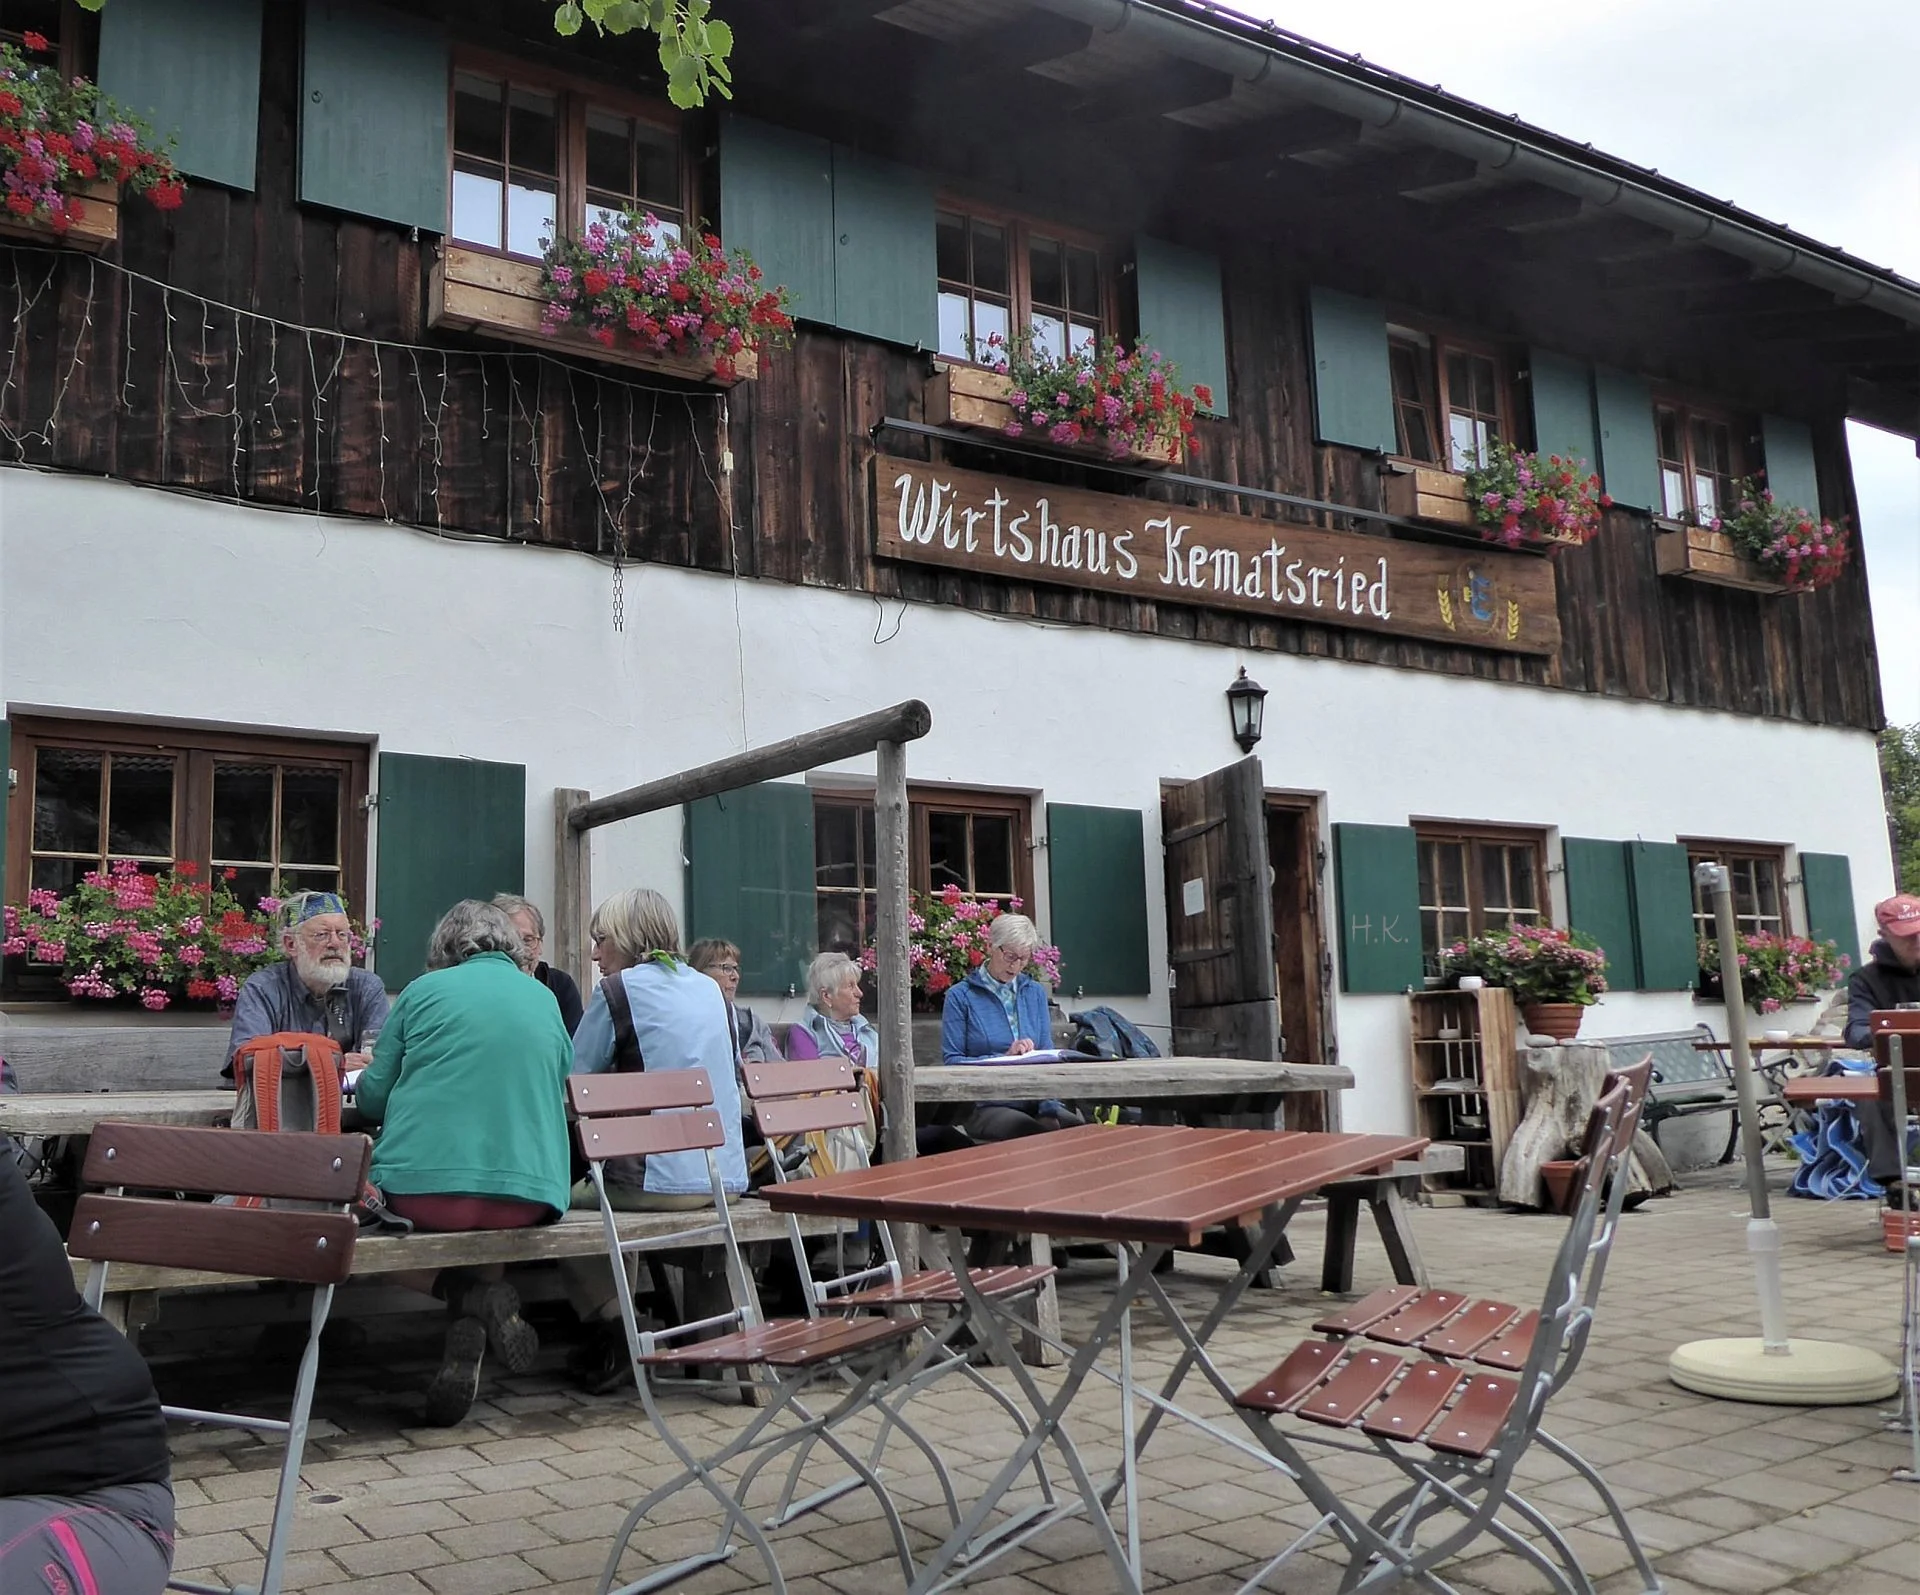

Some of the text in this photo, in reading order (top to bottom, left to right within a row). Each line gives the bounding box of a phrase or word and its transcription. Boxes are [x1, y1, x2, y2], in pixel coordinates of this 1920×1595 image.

[894, 473, 1392, 620] Wirtshaus Kematsried
[1351, 913, 1409, 945] H.K.
